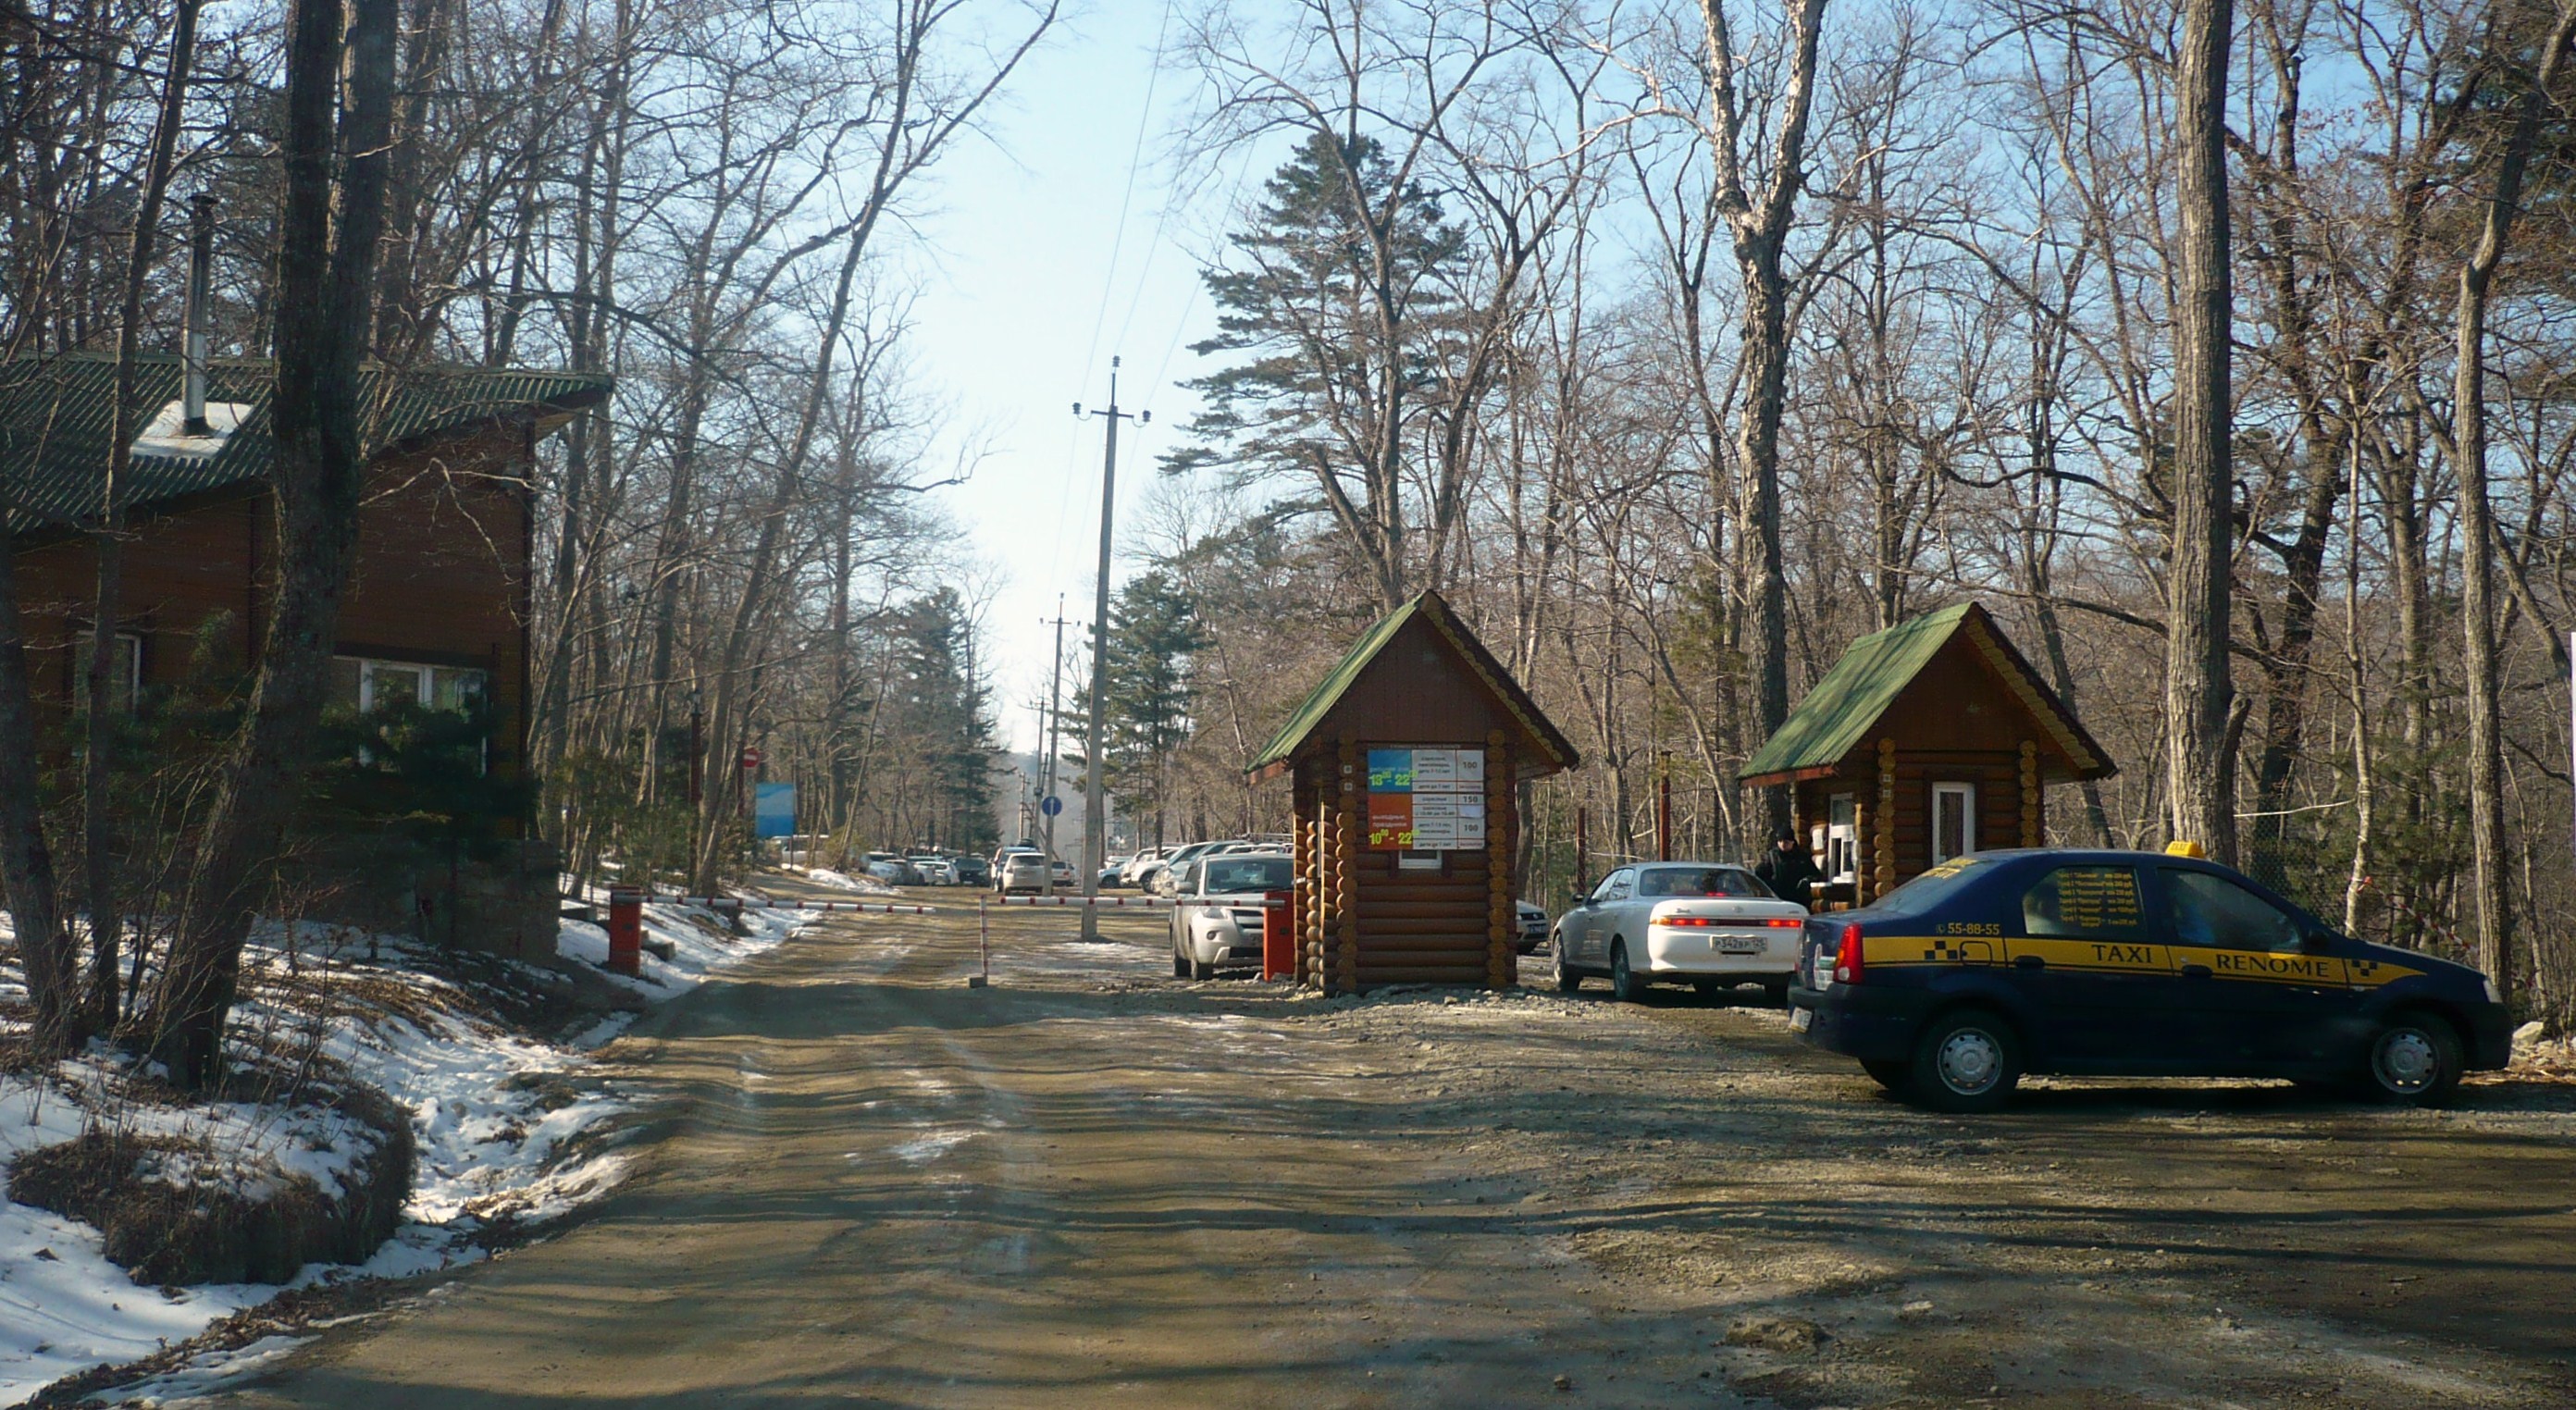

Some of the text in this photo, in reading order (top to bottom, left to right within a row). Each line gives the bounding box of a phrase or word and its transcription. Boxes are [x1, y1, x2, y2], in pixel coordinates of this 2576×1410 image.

[1464, 796, 1479, 804] 150
[1465, 823, 1480, 832] 100
[1947, 921, 2001, 936] 55-88-55
[2091, 944, 2330, 978] TAXI RENOME
